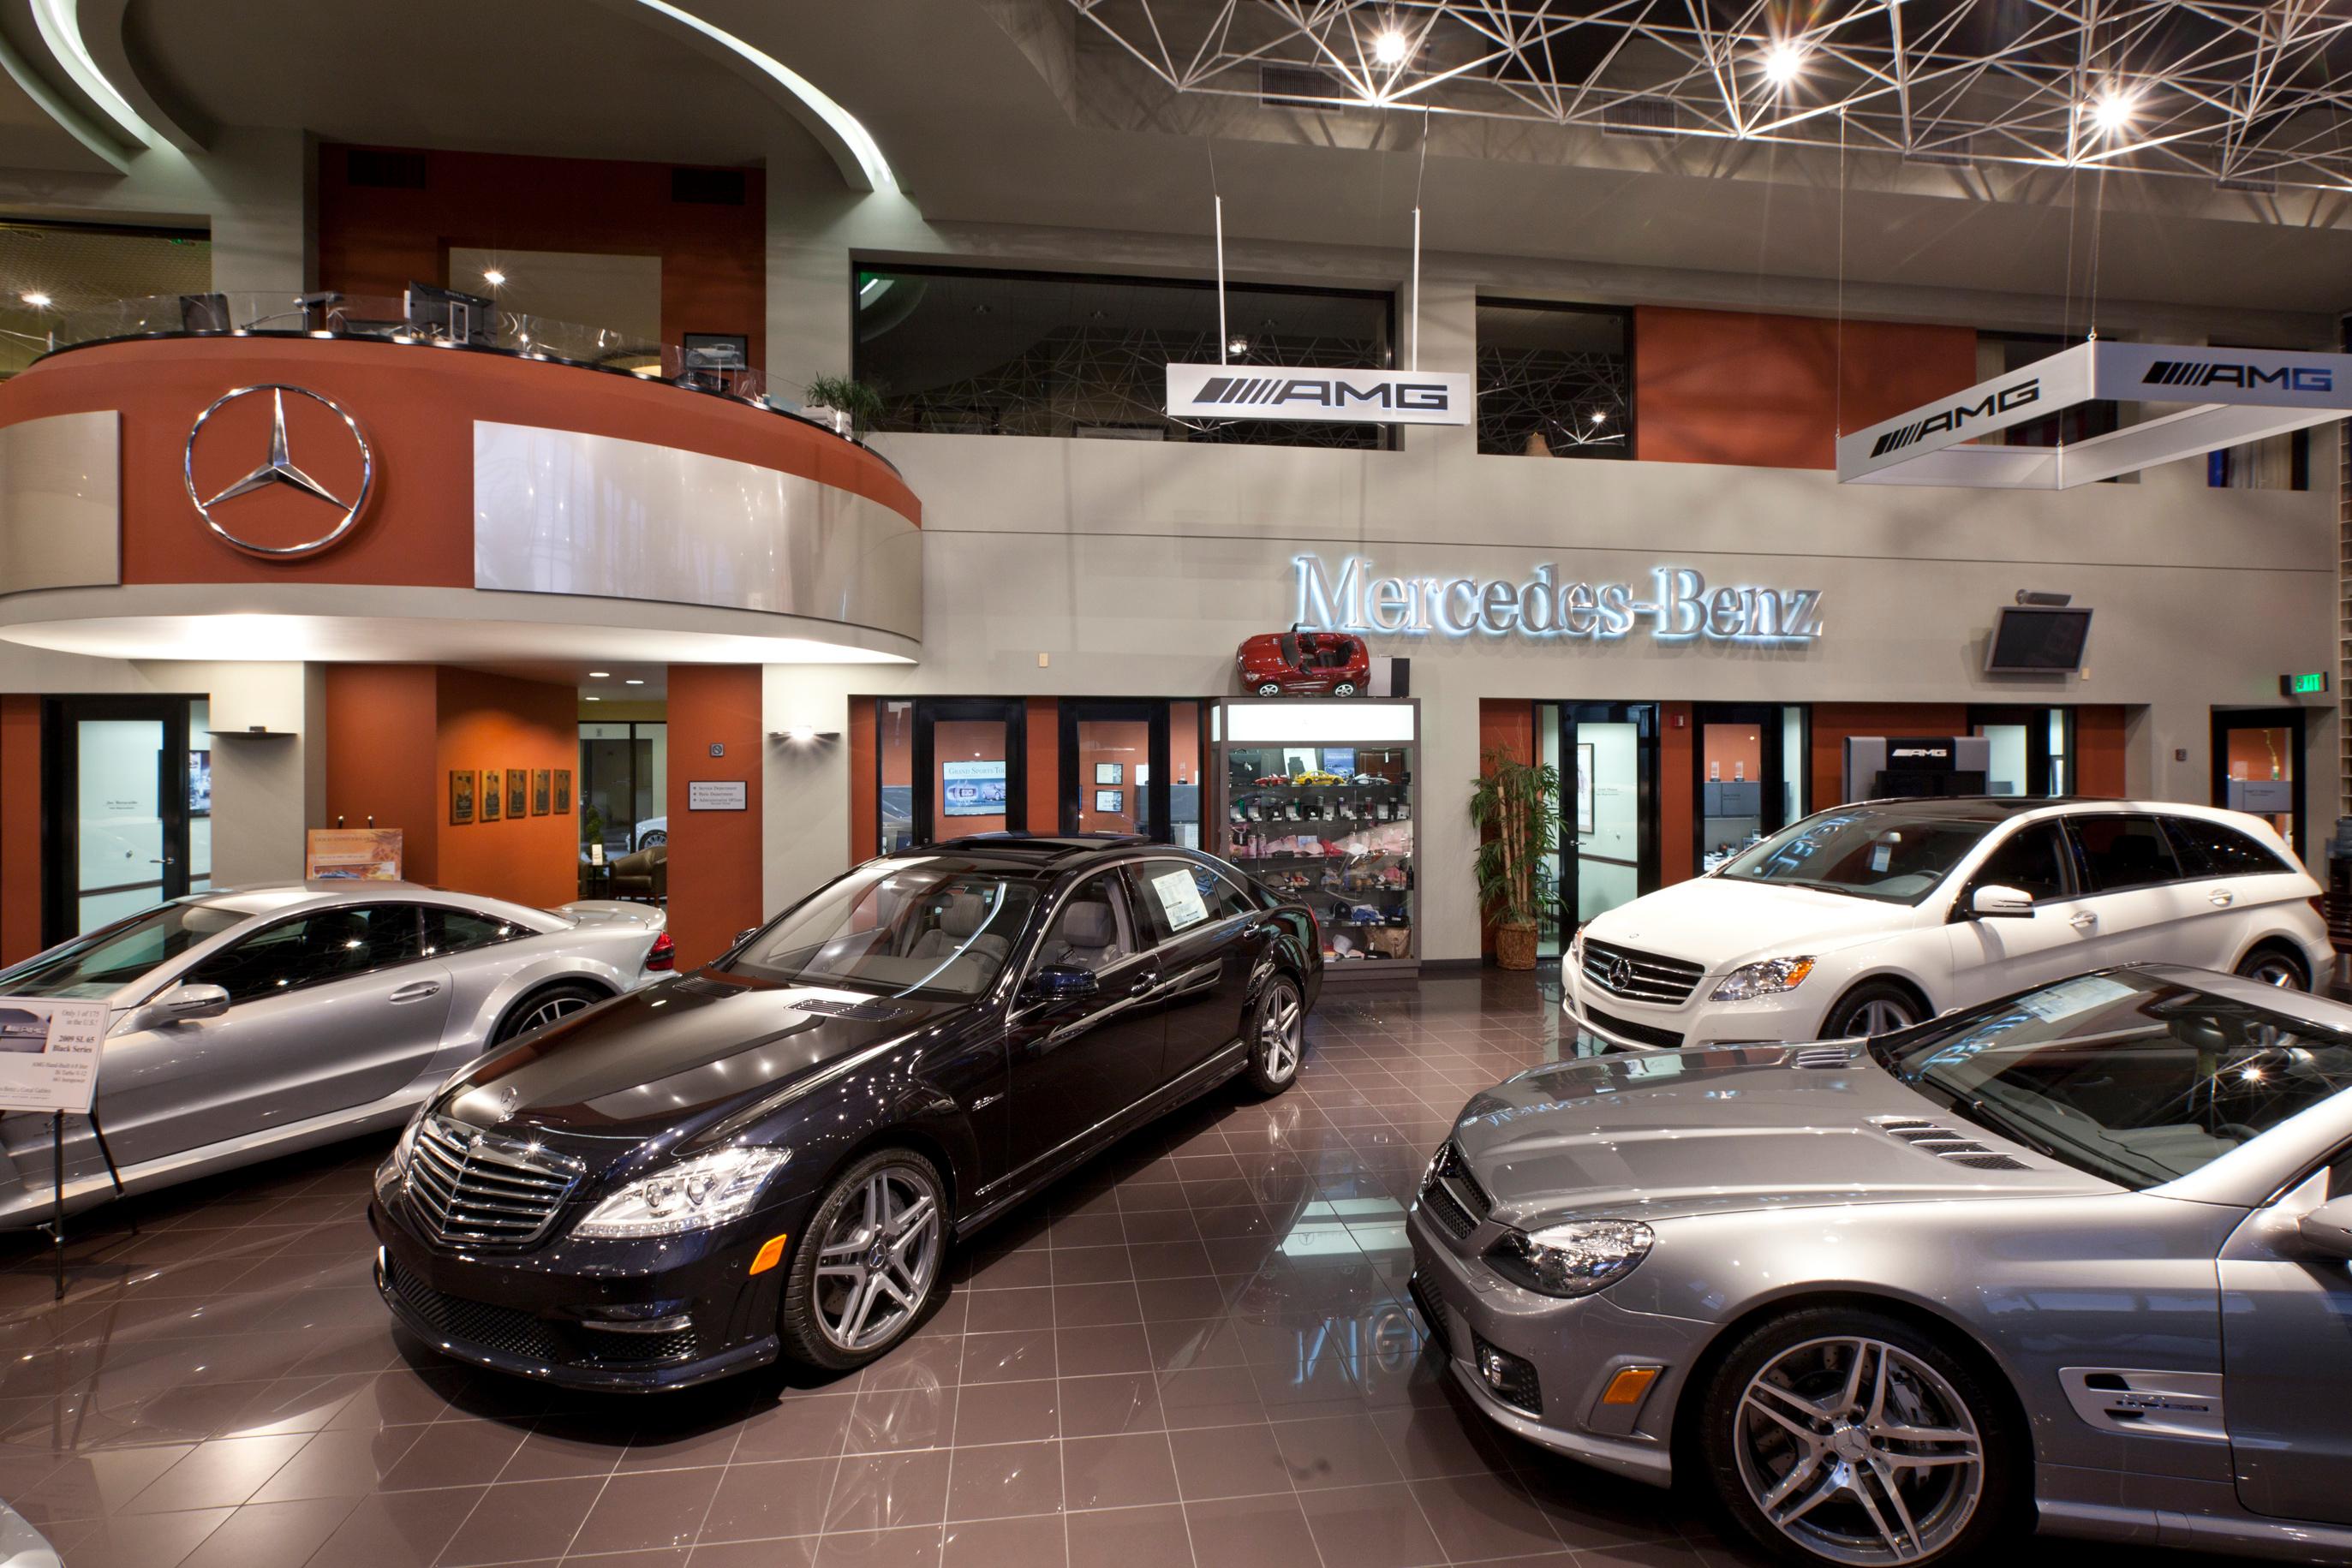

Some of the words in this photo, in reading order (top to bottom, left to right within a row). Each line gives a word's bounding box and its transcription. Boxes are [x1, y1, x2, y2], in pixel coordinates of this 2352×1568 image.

[2200, 364, 2332, 391] AMG
[1271, 379, 1448, 410] AMG
[1914, 378, 2039, 442] AMG
[1295, 556, 1824, 637] Mercedes-Benz
[2295, 673, 2320, 693] EXIT
[61, 1010, 75, 1018] Only
[71, 1045, 92, 1053] Series
